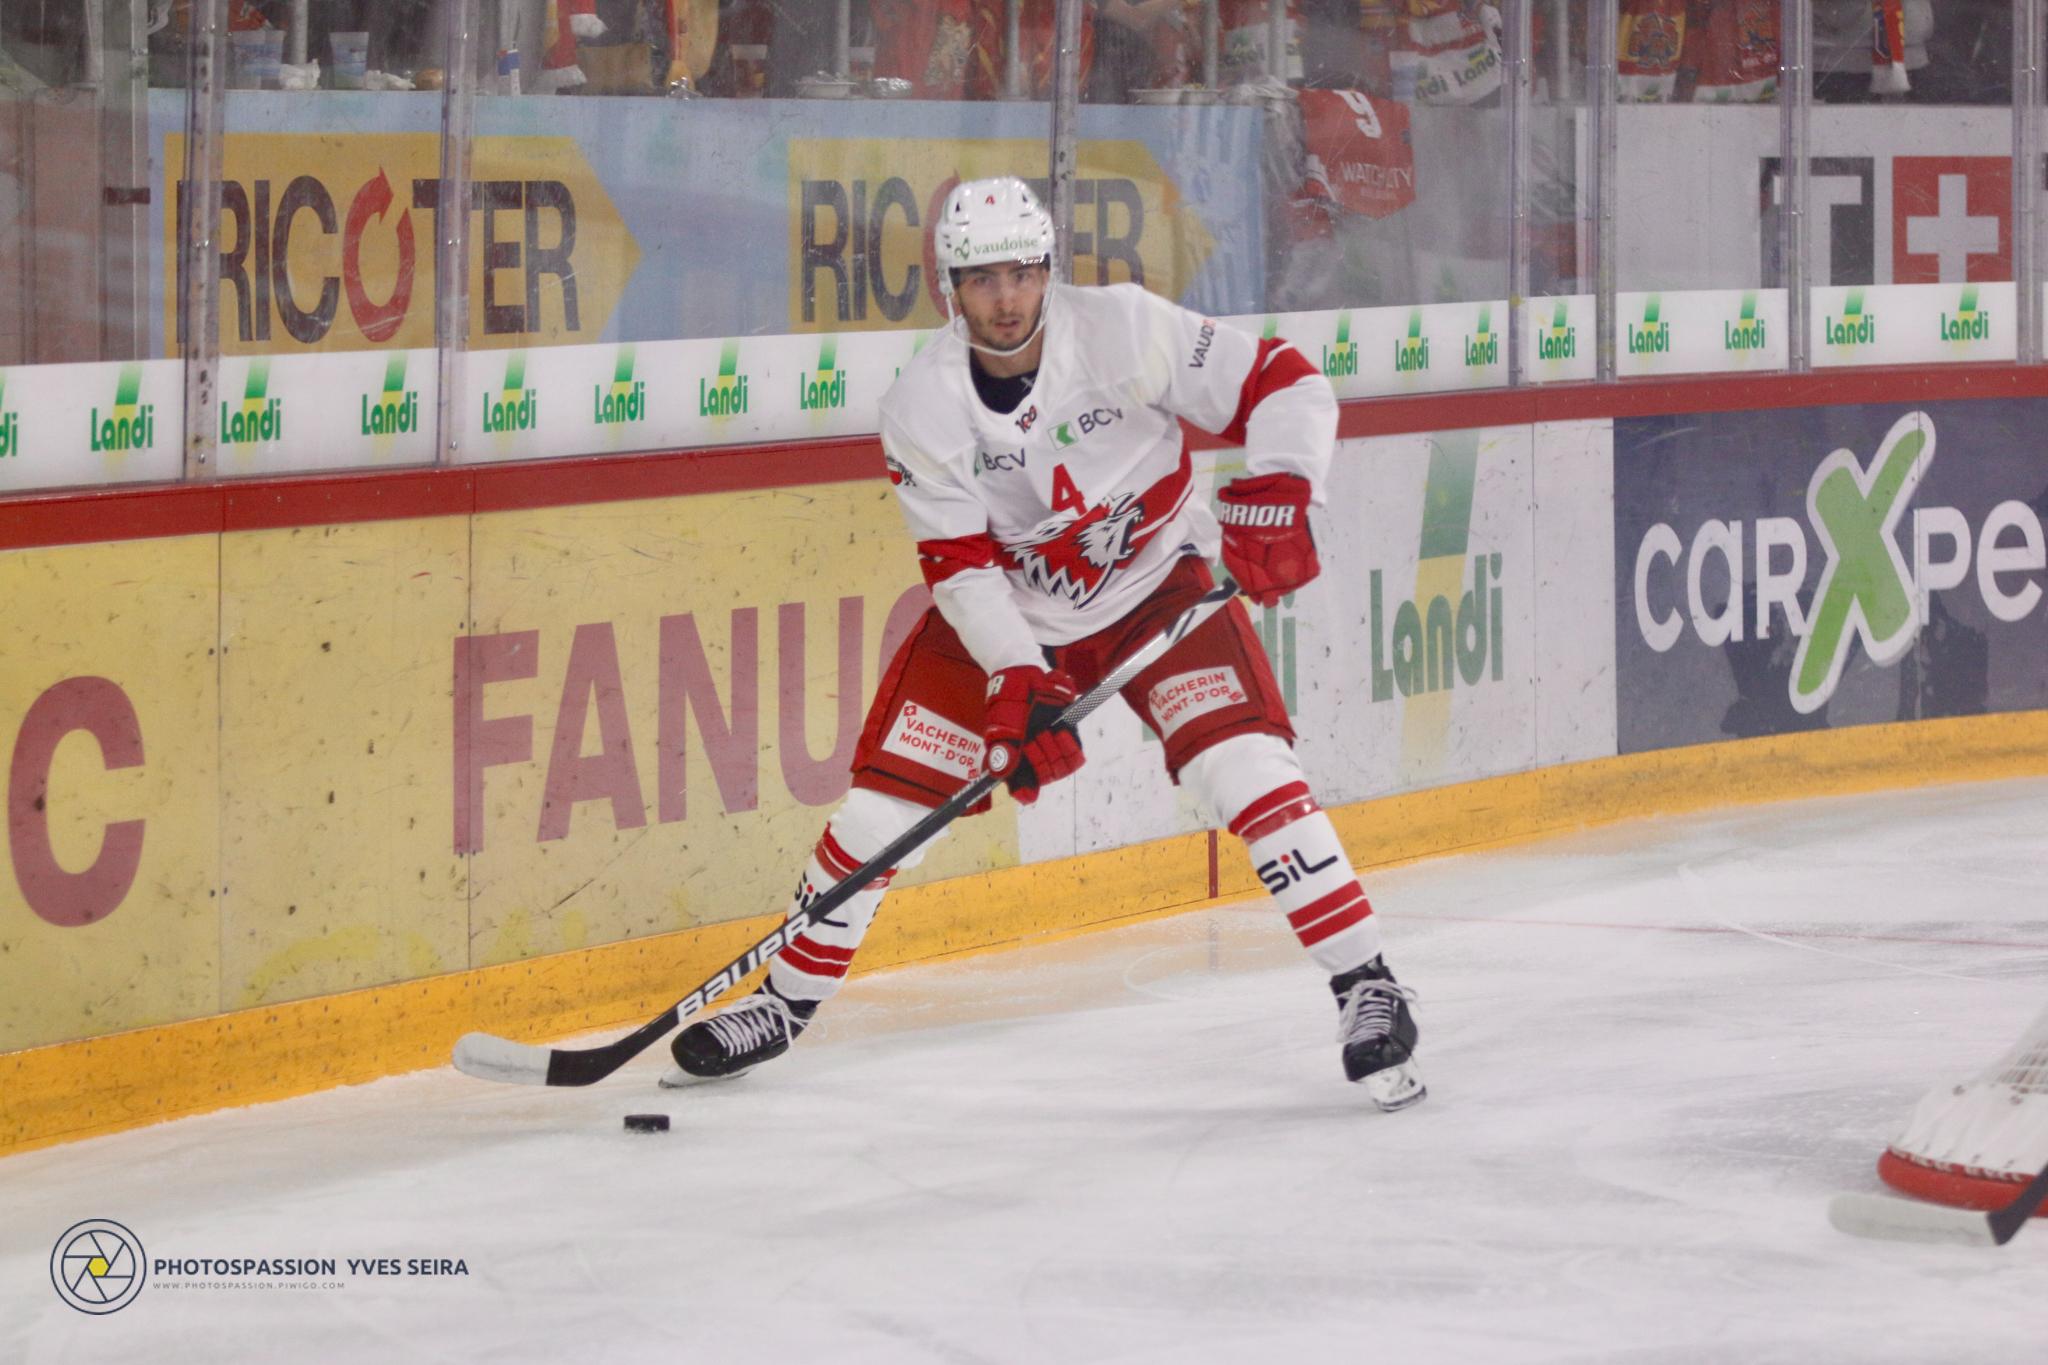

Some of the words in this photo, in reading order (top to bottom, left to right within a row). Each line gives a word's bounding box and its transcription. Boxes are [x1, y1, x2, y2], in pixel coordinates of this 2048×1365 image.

[1332, 89, 1382, 139] 9
[973, 237, 1039, 255] vaudoise
[1539, 326, 1575, 360] Landi
[1628, 322, 1670, 355] Landi
[1725, 319, 1765, 350] Landi
[1826, 314, 1874, 345] Landi
[1941, 311, 1988, 341] Landi
[1323, 342, 1358, 377] Landi
[1395, 337, 1429, 371] Landi
[1465, 333, 1498, 366] Landi
[594, 381, 646, 425] Landi
[699, 374, 748, 417] Landi
[800, 370, 845, 410] Landi
[91, 405, 154, 452] Landi
[220, 398, 281, 444] Landi
[361, 391, 418, 436] Landi
[482, 388, 537, 433] Landi
[1078, 407, 1124, 434] BCV
[982, 447, 1026, 472] BCV
[1368, 552, 1504, 704] Landi
[906, 717, 981, 754] VACHERIN
[7, 675, 146, 928] C
